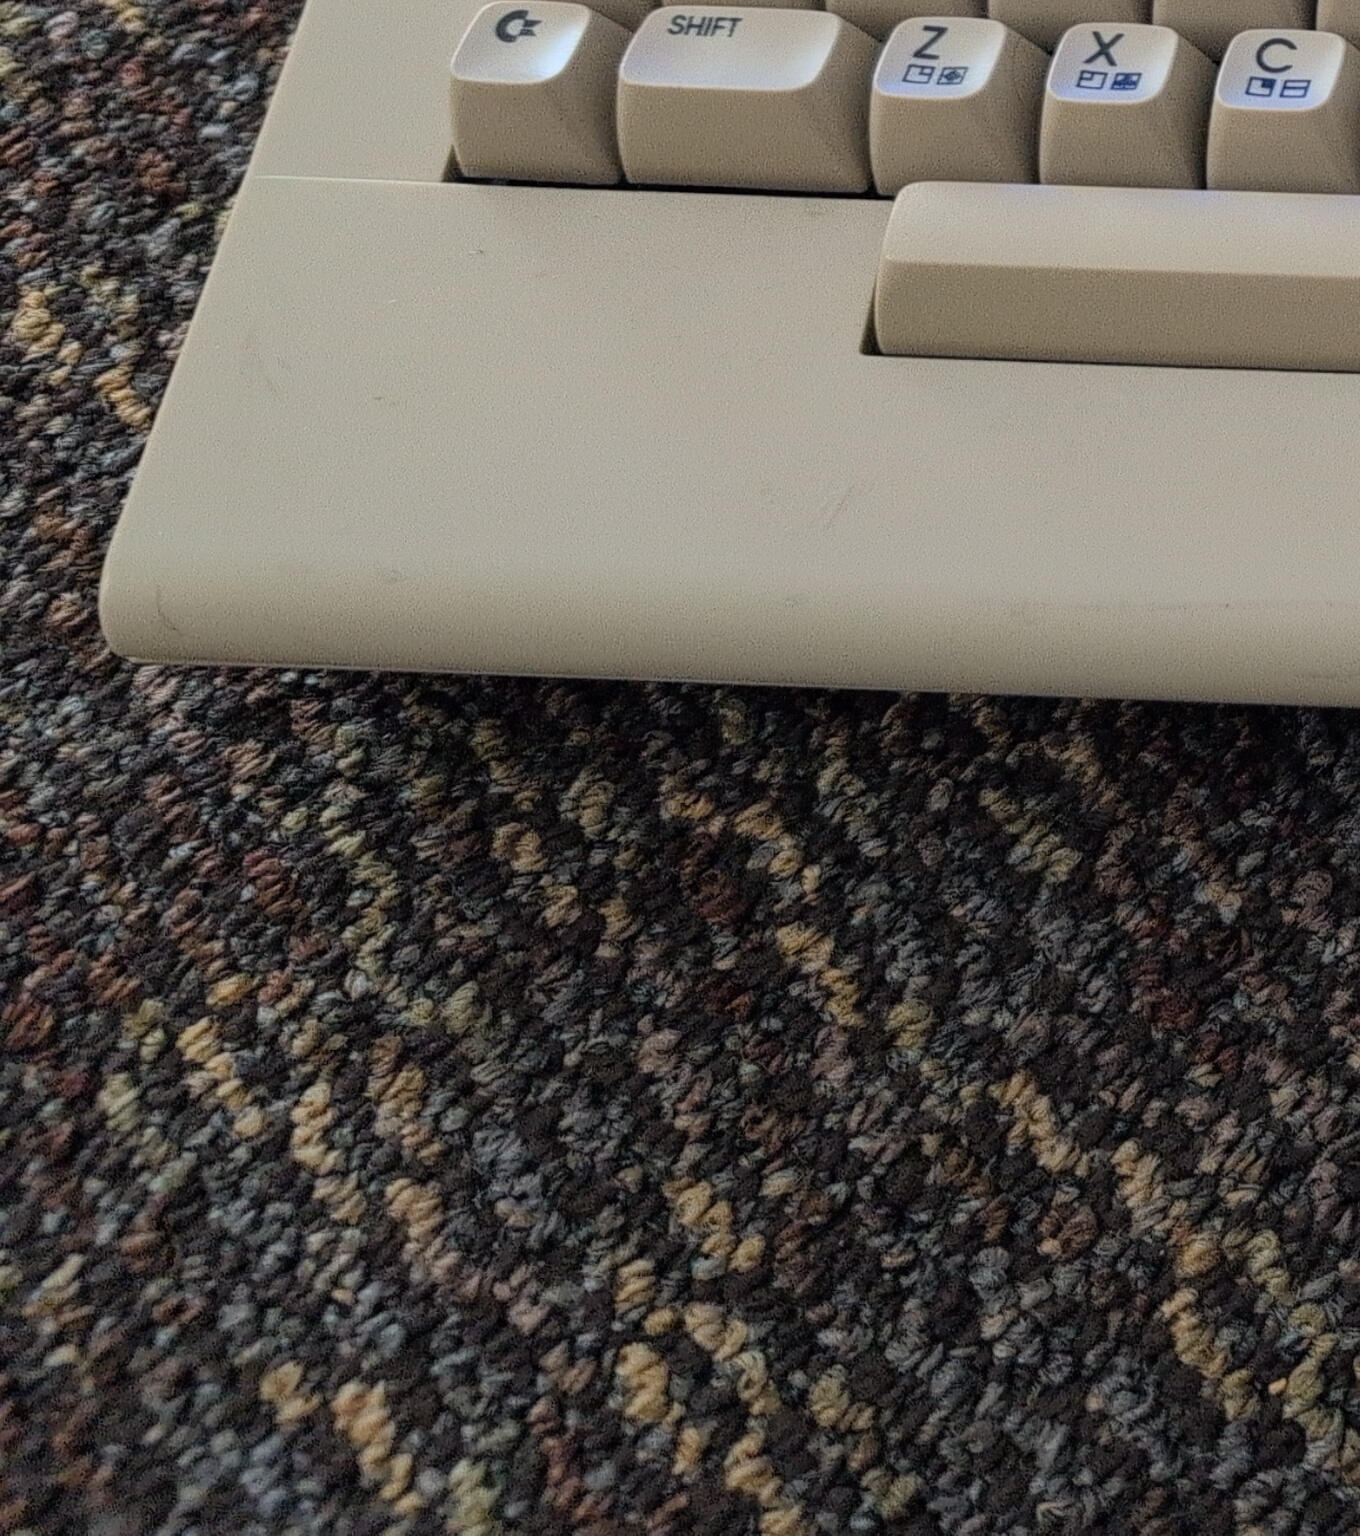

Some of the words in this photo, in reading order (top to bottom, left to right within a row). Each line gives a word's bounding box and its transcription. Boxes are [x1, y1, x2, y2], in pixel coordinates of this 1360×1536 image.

[667, 14, 742, 37] SHIFT
[912, 25, 948, 60] Z
[1084, 31, 1124, 67] X
[1255, 37, 1297, 74] C
